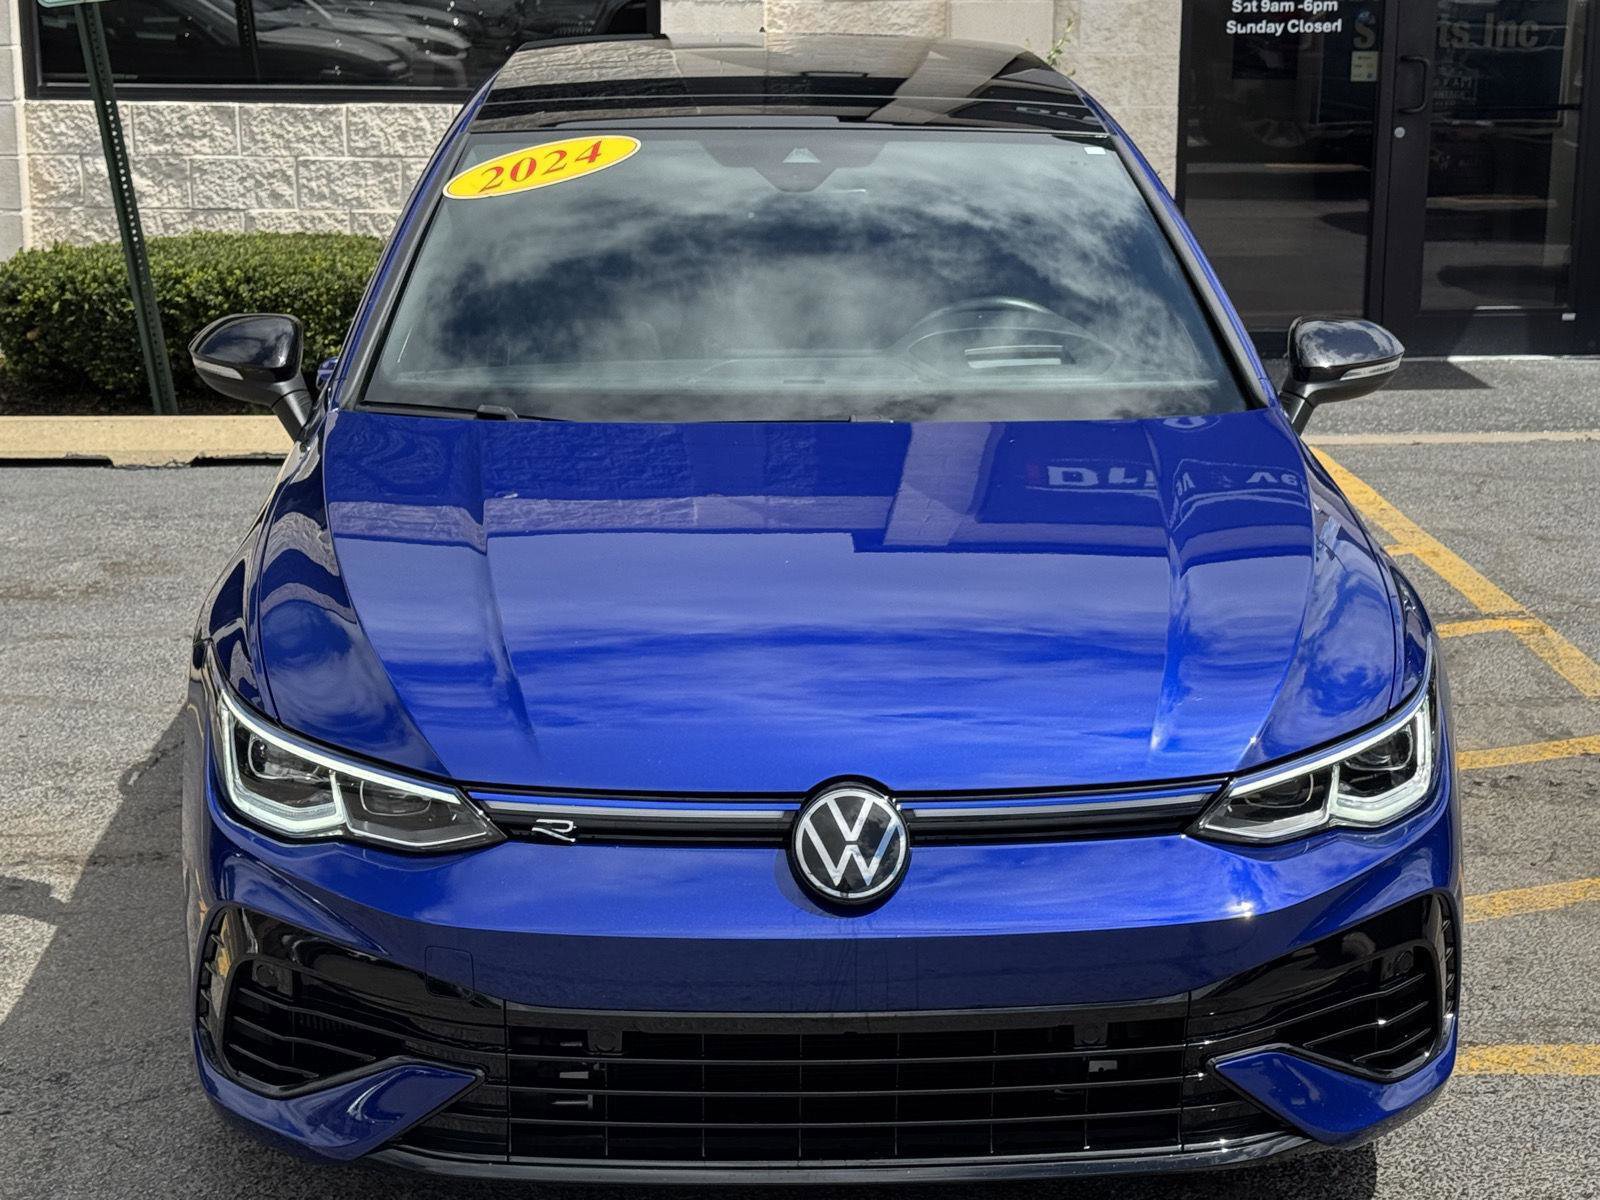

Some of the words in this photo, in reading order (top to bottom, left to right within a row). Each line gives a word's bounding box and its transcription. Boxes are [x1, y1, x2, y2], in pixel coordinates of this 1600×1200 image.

[1231, 0, 1257, 13] Sat
[1260, 0, 1295, 13] 9am
[1226, 20, 1285, 36] Sunday
[1287, 18, 1342, 33] Closed
[1485, 12, 1539, 48] Inc
[479, 140, 602, 194] 2024
